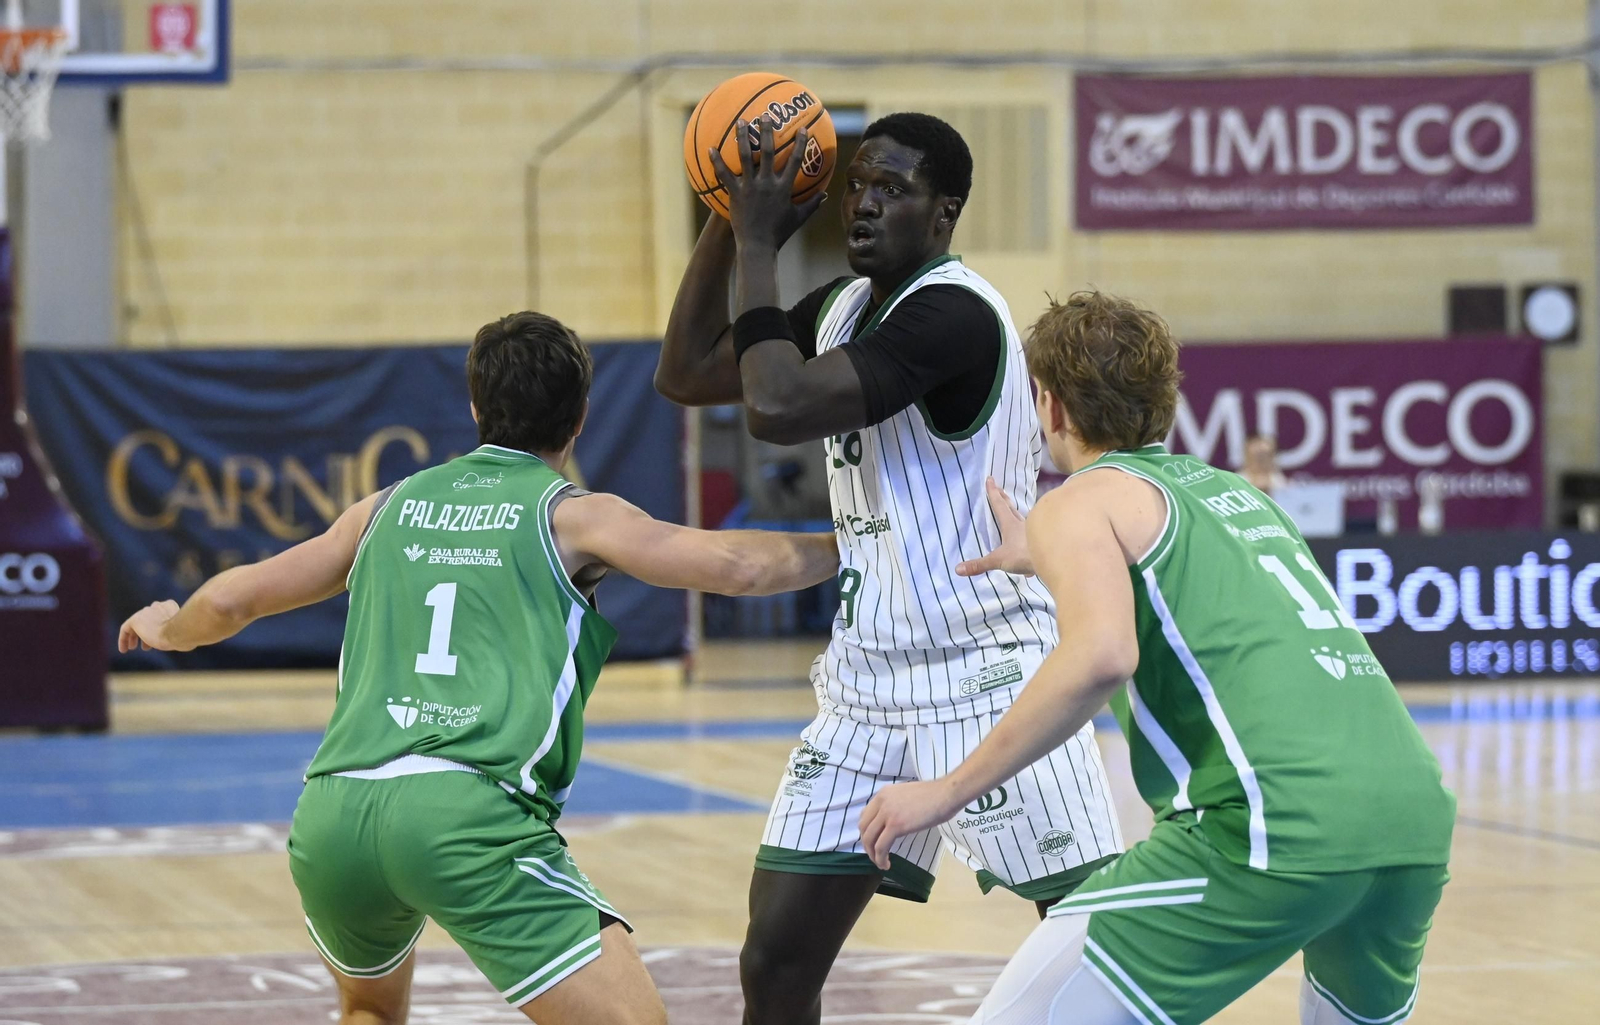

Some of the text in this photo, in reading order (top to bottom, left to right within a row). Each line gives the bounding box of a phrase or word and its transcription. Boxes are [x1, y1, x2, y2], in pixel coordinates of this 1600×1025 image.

[735, 91, 817, 151] lson
[1189, 102, 1520, 176] IMDECO
[1166, 379, 1534, 470] MDECO
[1200, 487, 1268, 518] RCÍA
[398, 499, 524, 532] PALAZUELOS
[428, 556, 502, 567] EXTREMADURA
[430, 548, 498, 557] CAJA RURAL DE
[414, 582, 458, 676] 1
[1352, 665, 1364, 676] DE
[420, 714, 478, 728] DE CÁCERES
[422, 702, 482, 717] DIPUTACIÓN
[957, 807, 1024, 830] SohoBoutique
[979, 823, 1005, 834] HOTELS
